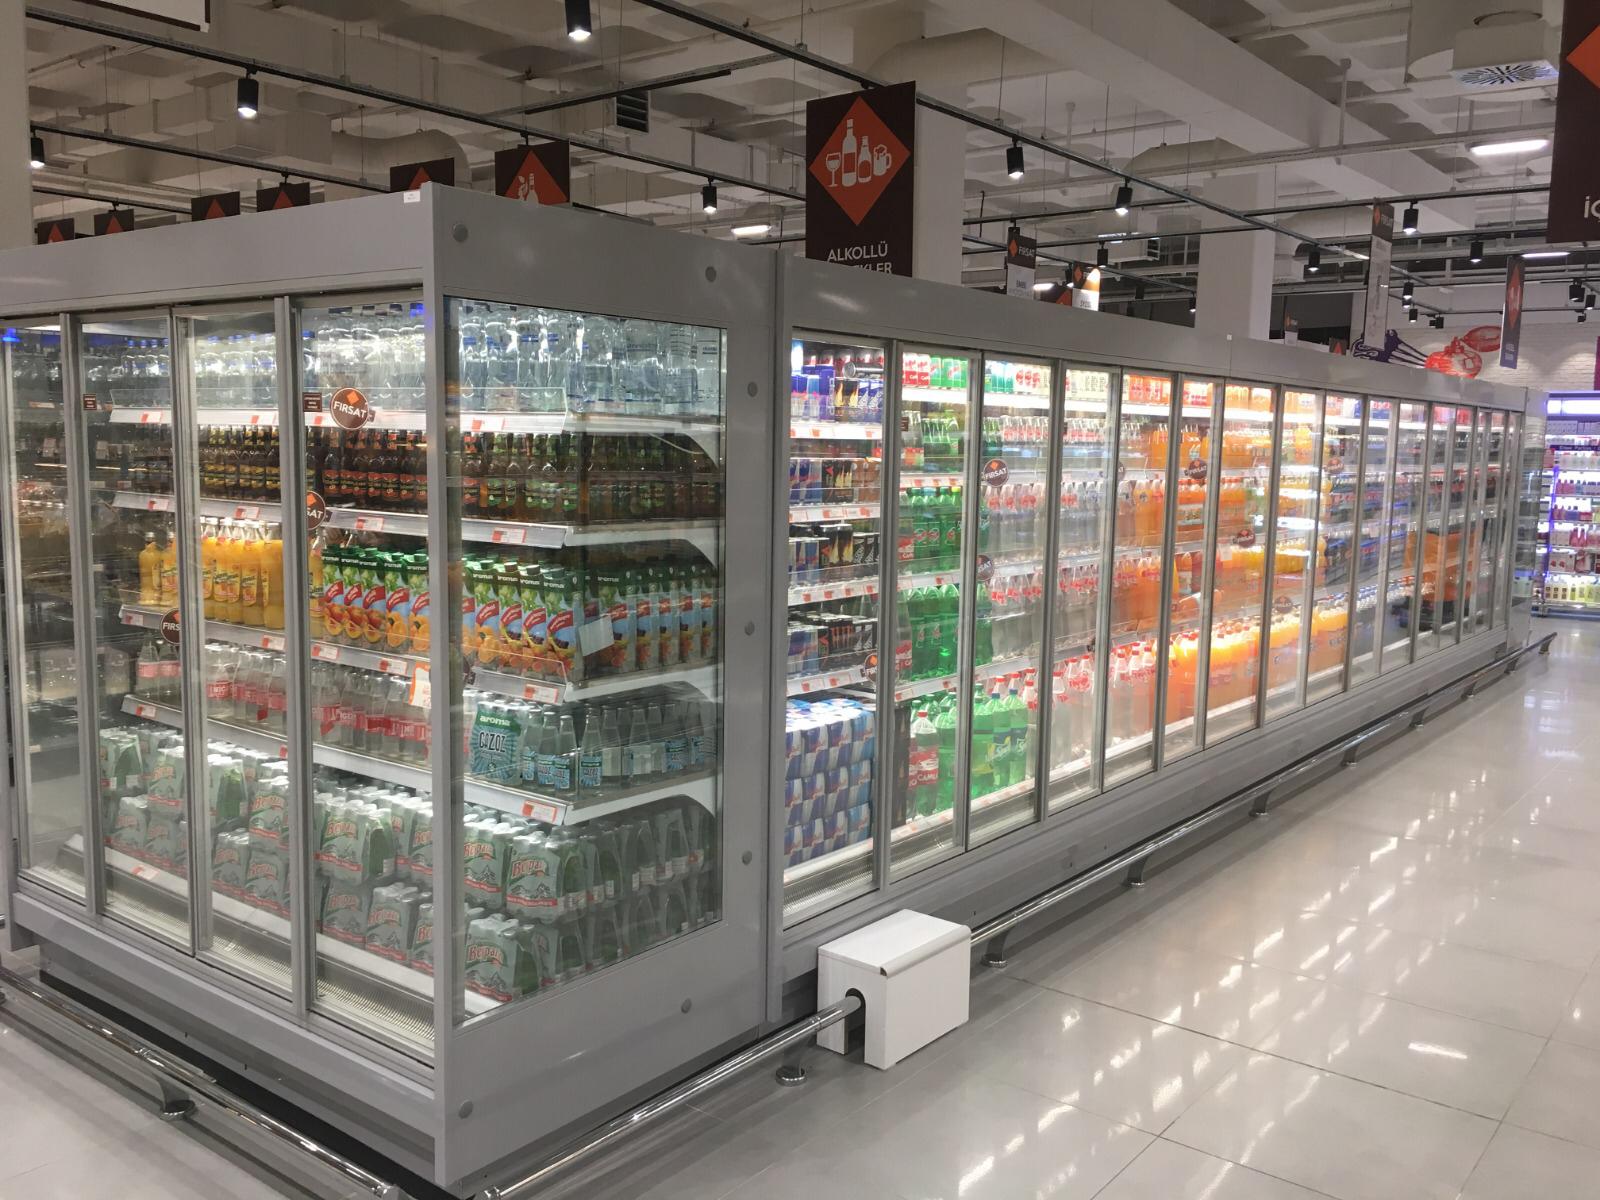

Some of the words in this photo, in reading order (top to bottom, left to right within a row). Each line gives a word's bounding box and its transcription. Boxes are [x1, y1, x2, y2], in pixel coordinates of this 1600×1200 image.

[827, 241, 888, 262] ALKOLLÜ
[333, 401, 366, 418] FIRSAT
[479, 713, 511, 727] aroma
